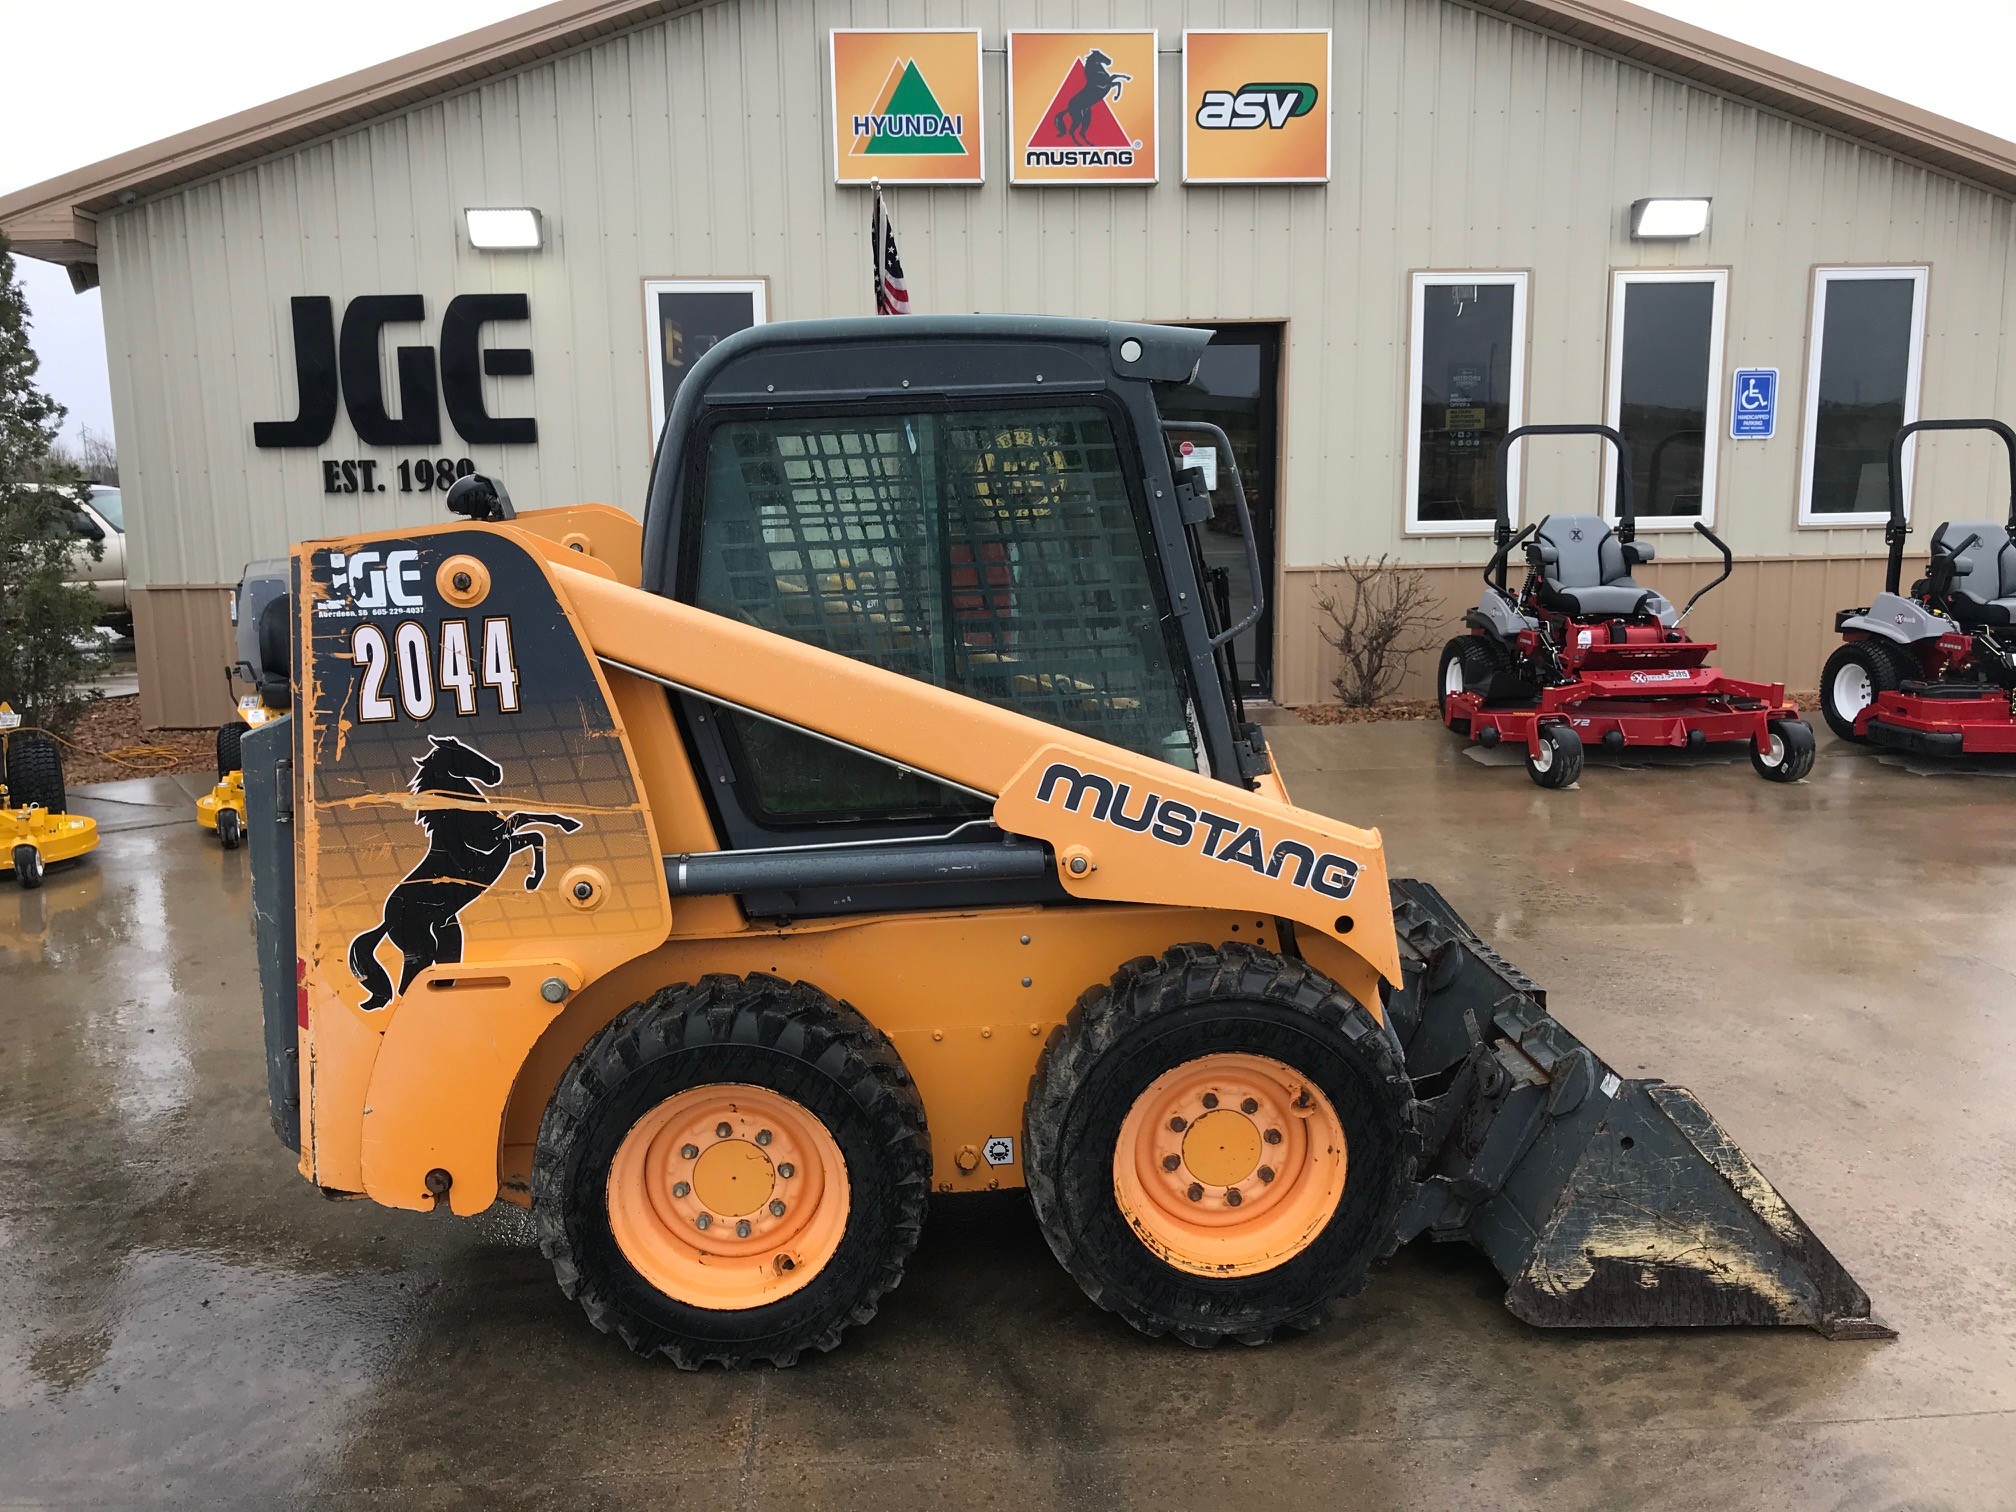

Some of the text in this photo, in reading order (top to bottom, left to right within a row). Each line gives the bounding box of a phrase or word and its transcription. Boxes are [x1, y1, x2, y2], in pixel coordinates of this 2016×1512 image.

[852, 114, 963, 137] HYUNDAI
[1026, 150, 1134, 166] MUSTANG
[253, 293, 538, 448] JGE
[322, 459, 386, 493] EST.
[350, 617, 519, 723] 2044
[1036, 762, 1360, 900] MUSTANG
